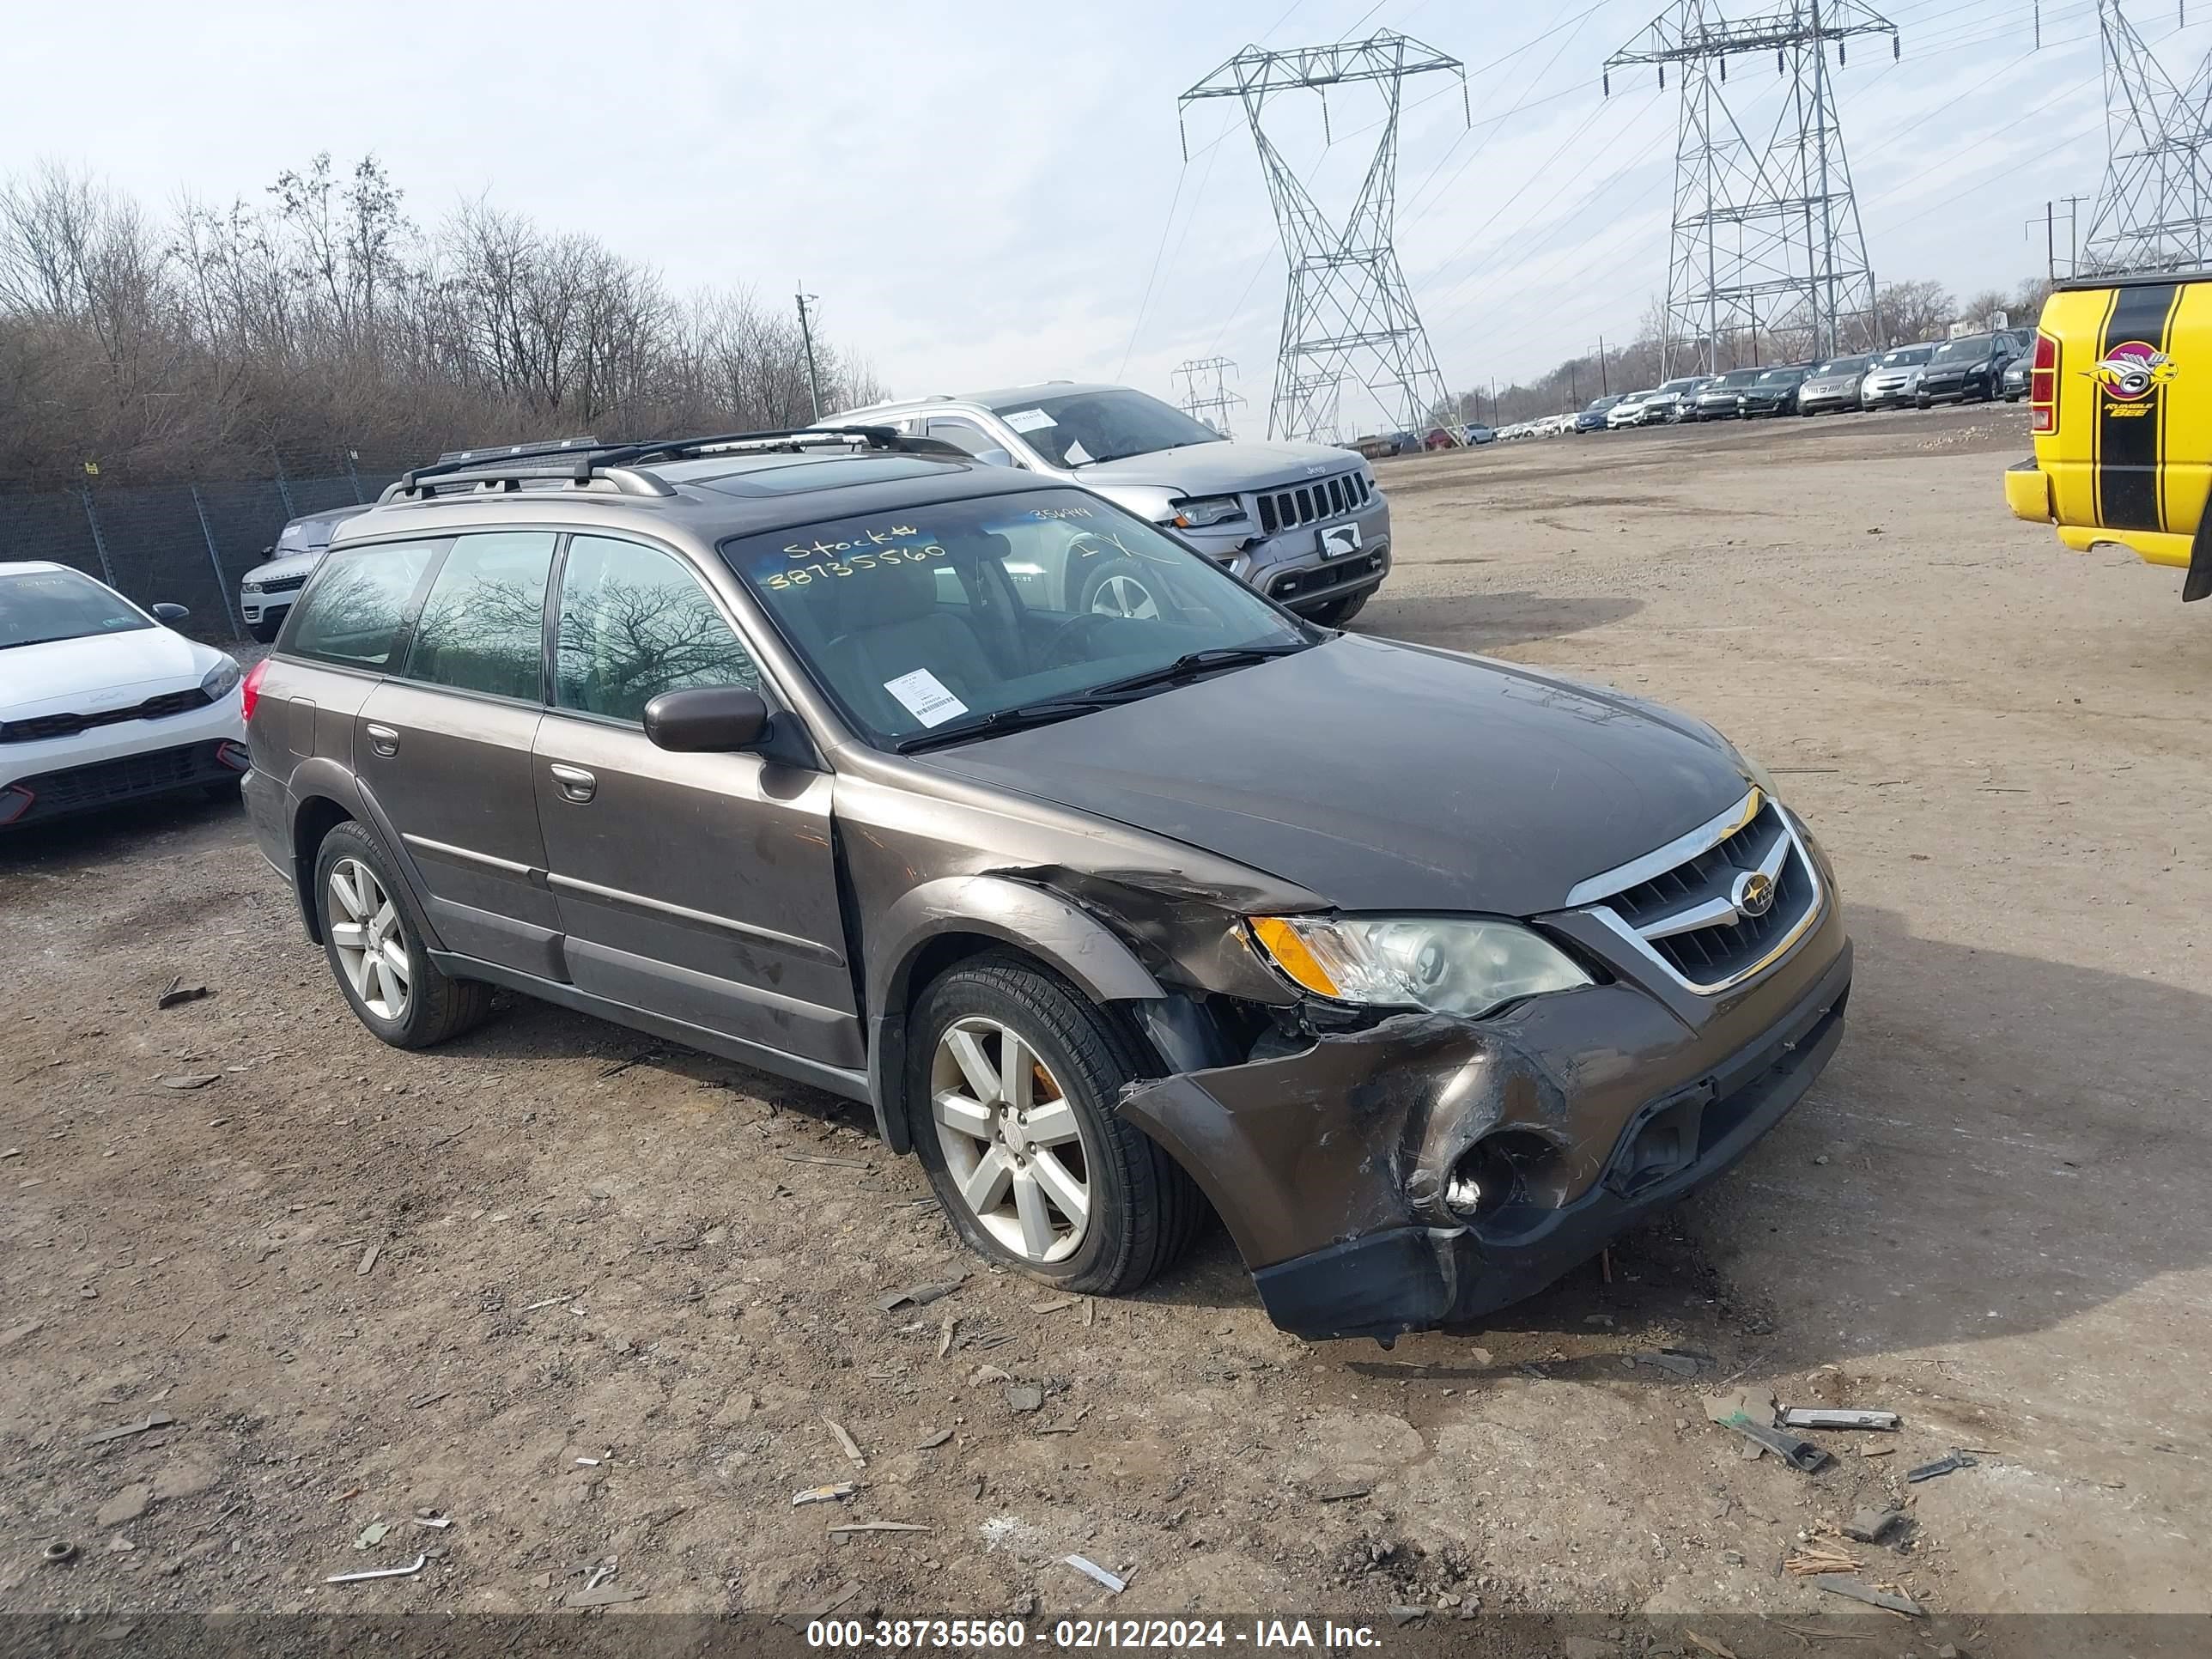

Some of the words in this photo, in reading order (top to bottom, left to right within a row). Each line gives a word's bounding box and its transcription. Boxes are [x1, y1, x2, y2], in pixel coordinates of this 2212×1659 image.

[2110, 409, 2148, 417] BEE
[1306, 466, 1327, 475] Jeep
[783, 526, 917, 558] Stock#
[768, 546, 945, 590] 38735560
